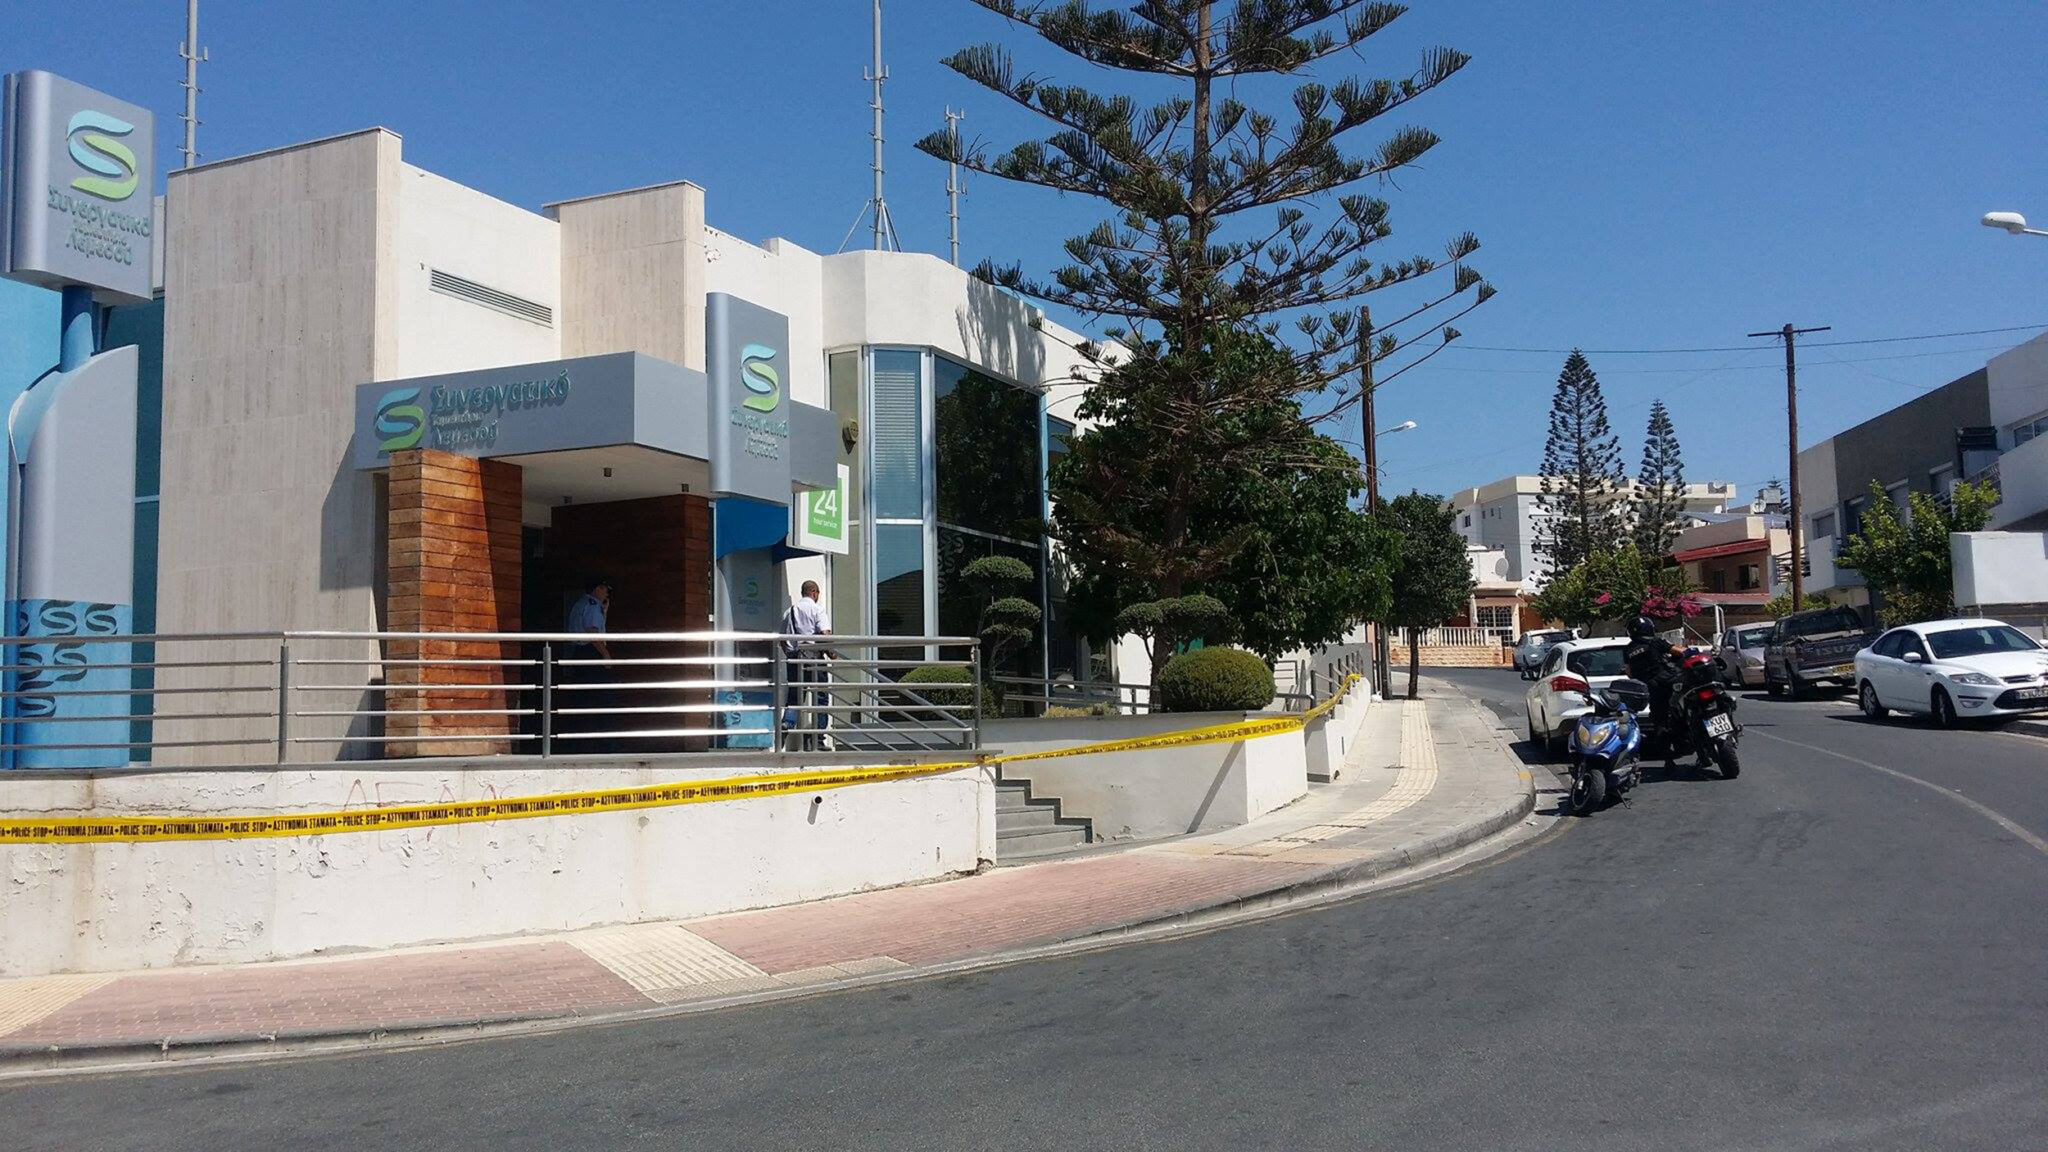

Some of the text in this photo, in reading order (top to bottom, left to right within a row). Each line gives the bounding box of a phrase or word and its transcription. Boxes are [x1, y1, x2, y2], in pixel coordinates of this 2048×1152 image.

[430, 368, 571, 413] Συνεργατικό
[813, 489, 838, 517] 24
[1714, 722, 1731, 734] 610
[11, 827, 31, 837] POLICE
[33, 827, 48, 837] STOP
[119, 825, 140, 835] POLICE
[142, 825, 157, 835] STOP
[229, 823, 250, 833] POLICE
[252, 822, 267, 832] STOP
[342, 816, 363, 826] POLICE
[366, 815, 381, 825] STOP
[454, 807, 473, 818] POLICE
[476, 806, 490, 816] STOP
[560, 798, 579, 809] POLICE
[581, 797, 595, 808] STOP
[662, 790, 680, 800] POLICE
[682, 789, 695, 799] STOP
